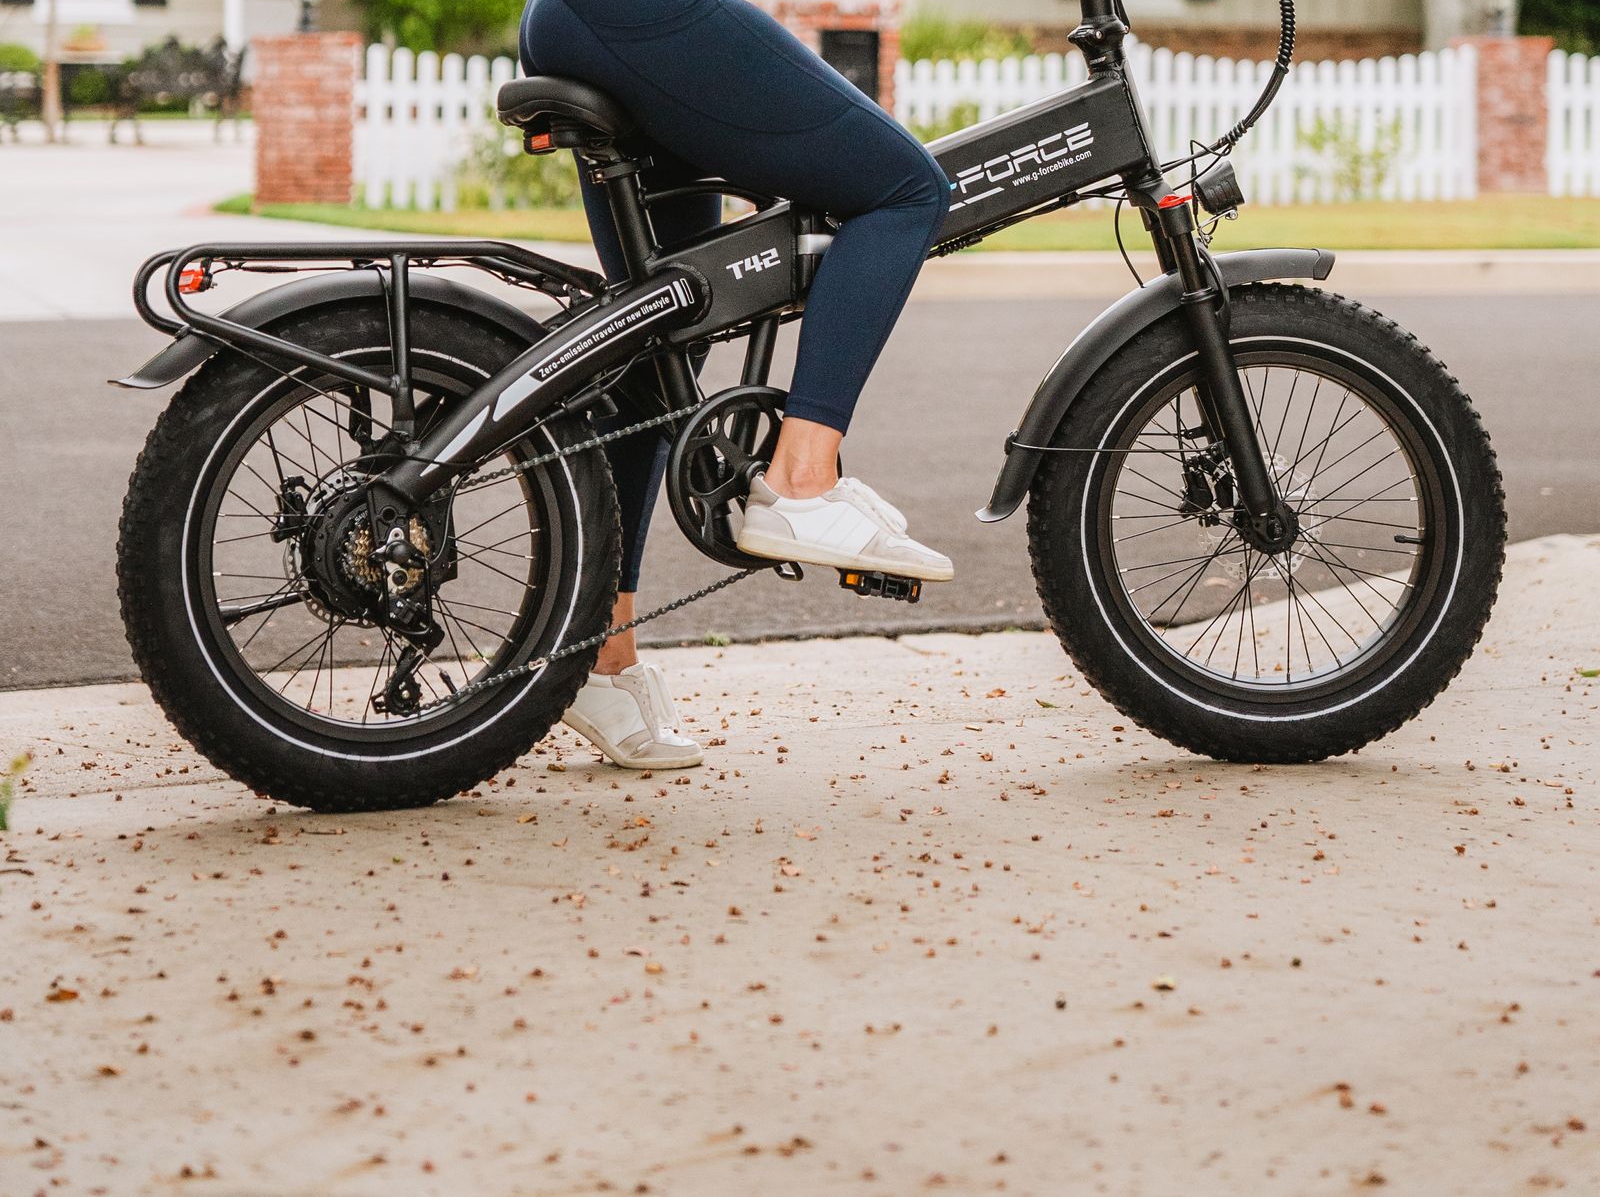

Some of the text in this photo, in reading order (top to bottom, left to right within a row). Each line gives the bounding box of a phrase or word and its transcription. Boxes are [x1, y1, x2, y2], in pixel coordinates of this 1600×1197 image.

[1012, 150, 1092, 186] www.g-forcebike.com
[726, 247, 781, 280] T42
[539, 296, 670, 378] Zero-emission travel for new lifestyle
